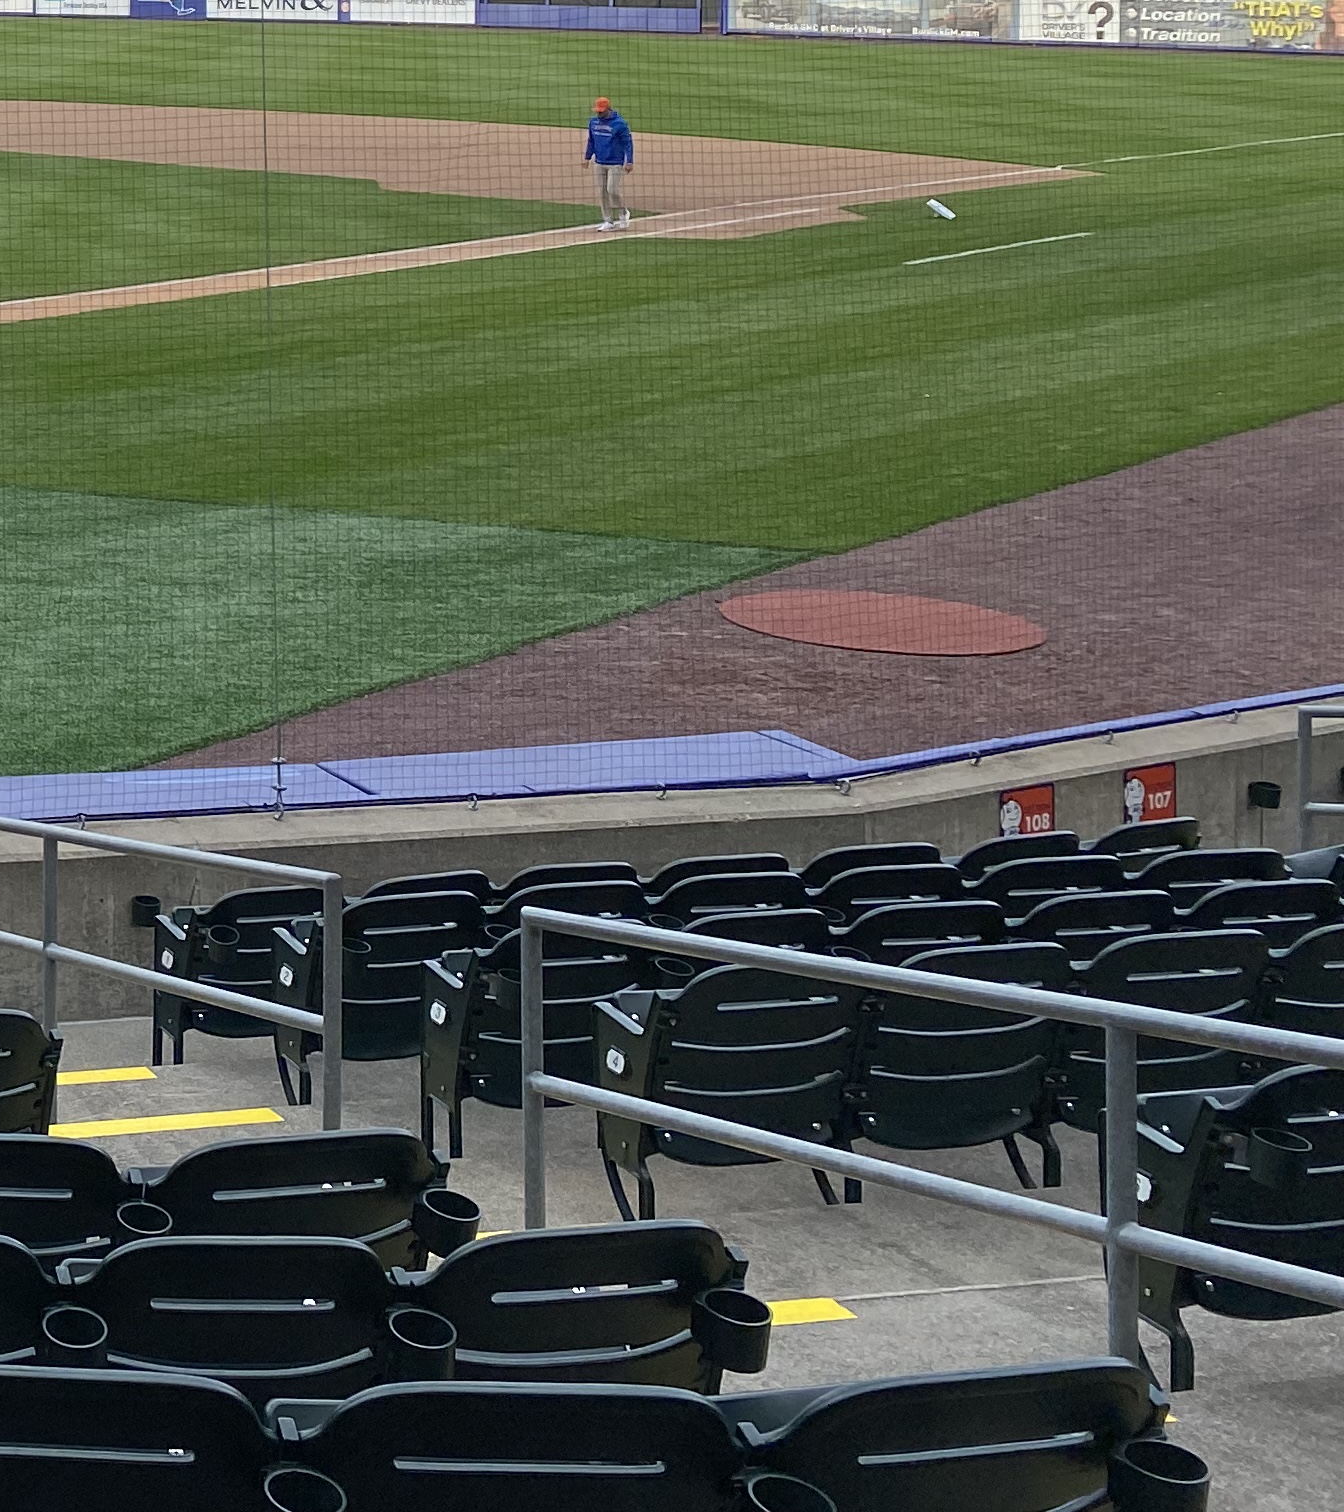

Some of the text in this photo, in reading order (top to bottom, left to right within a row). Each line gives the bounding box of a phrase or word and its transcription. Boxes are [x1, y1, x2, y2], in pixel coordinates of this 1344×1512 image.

[1140, 8, 1221, 22] Location
[863, 25, 892, 35] Village
[1042, 23, 1085, 31] DRIVER'S
[1042, 31, 1085, 39] VILLAGE
[1141, 27, 1221, 42] Tradition
[1148, 790, 1174, 811] 107
[1025, 813, 1050, 833] 108
[283, 970, 290, 982] 2
[434, 1006, 442, 1020] 3
[612, 1055, 619, 1068] 4
